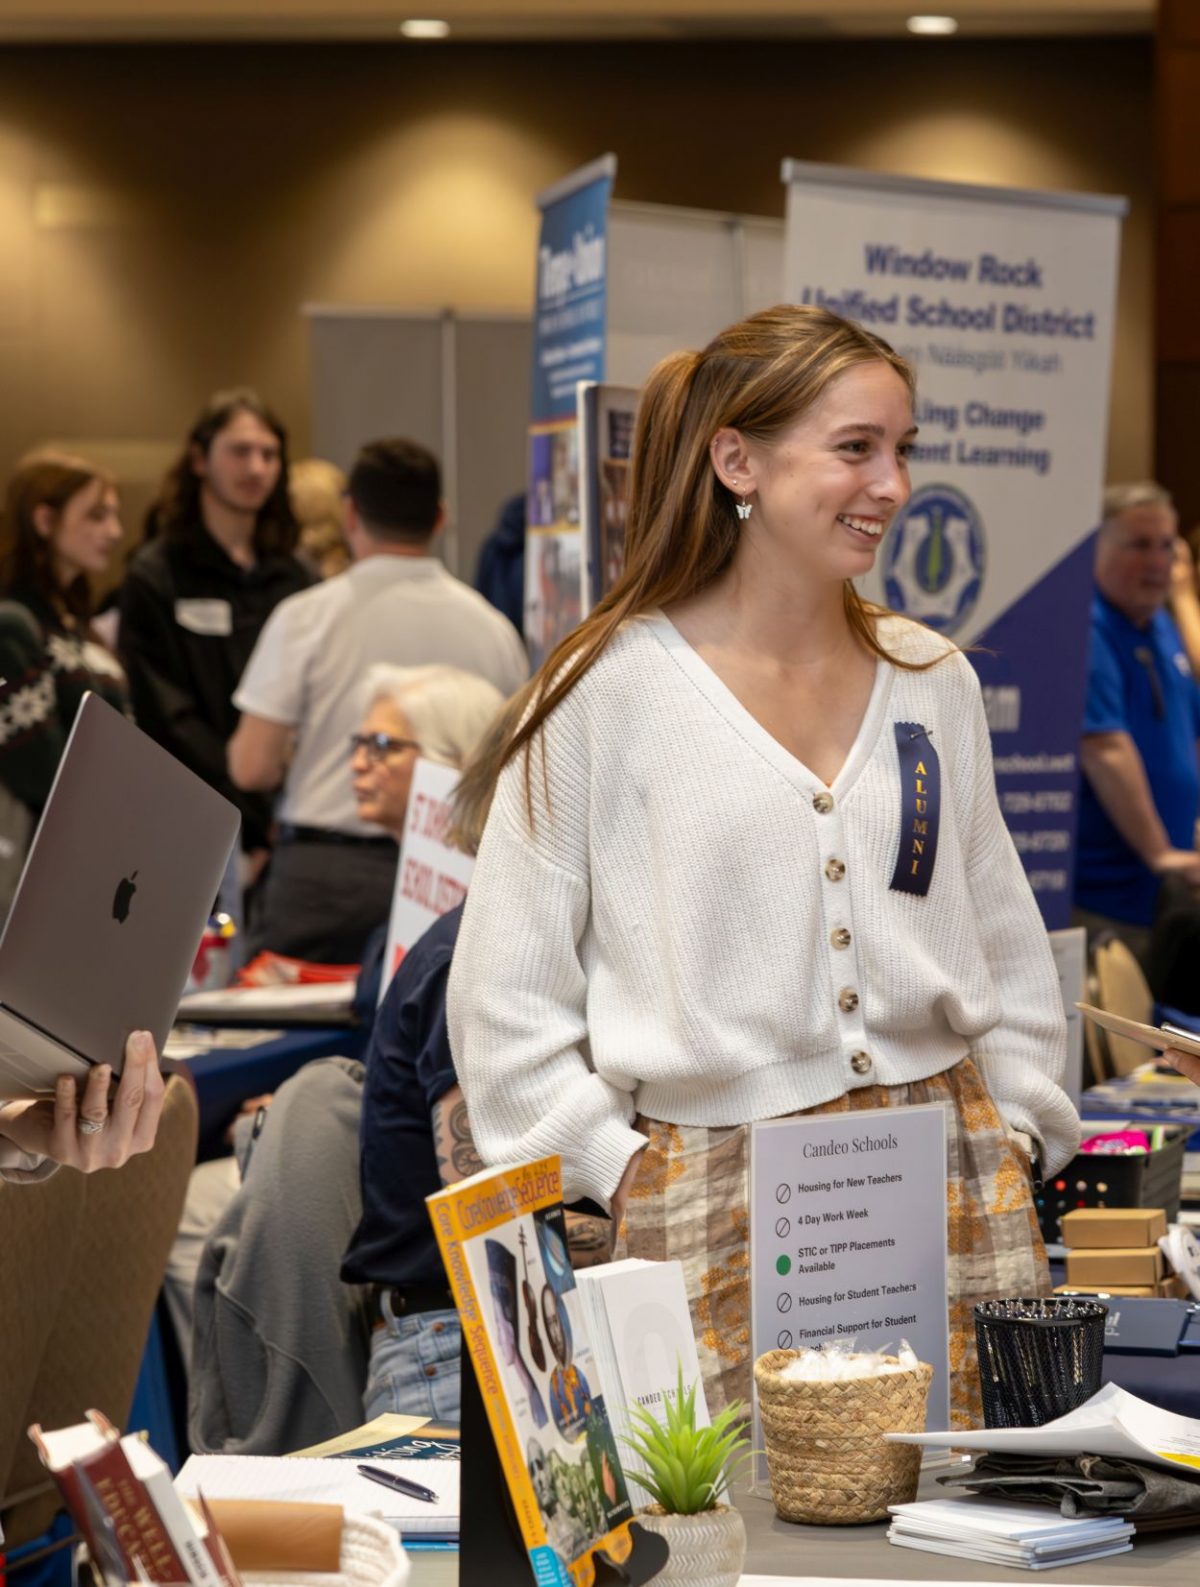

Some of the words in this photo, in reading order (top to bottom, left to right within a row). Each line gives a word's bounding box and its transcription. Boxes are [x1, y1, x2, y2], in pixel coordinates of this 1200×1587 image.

[864, 244, 971, 282] Window
[978, 254, 1042, 288] Rock
[906, 294, 996, 331] School
[1002, 302, 1094, 339] District
[964, 402, 1045, 435] Change
[957, 440, 1052, 476] Learning
[910, 760, 928, 876] ALUMNI
[803, 1139, 849, 1158] Candeo
[852, 1133, 898, 1153] Schools
[798, 1179, 832, 1193] Housing
[832, 1178, 845, 1189] for
[847, 1177, 866, 1188] New
[867, 1173, 903, 1185] Teachers
[797, 1215, 803, 1225] 4
[805, 1215, 820, 1226] Day
[822, 1211, 844, 1222] Work
[846, 1208, 869, 1219] Week
[798, 1246, 817, 1258] STIC
[819, 1248, 828, 1256] or
[830, 1243, 848, 1254] TIPP
[849, 1238, 896, 1251] Placements
[798, 1261, 836, 1274] Available
[435, 1203, 454, 1236] Core
[446, 1240, 479, 1322] Knowledge
[468, 1324, 499, 1396] Sequence
[799, 1293, 832, 1307] Housing
[834, 1291, 846, 1302] for
[847, 1287, 879, 1300] Student
[881, 1282, 917, 1295] Teachers
[799, 1325, 836, 1339] Financial
[837, 1320, 870, 1334] Support
[871, 1318, 883, 1328] for
[884, 1314, 916, 1327] Student
